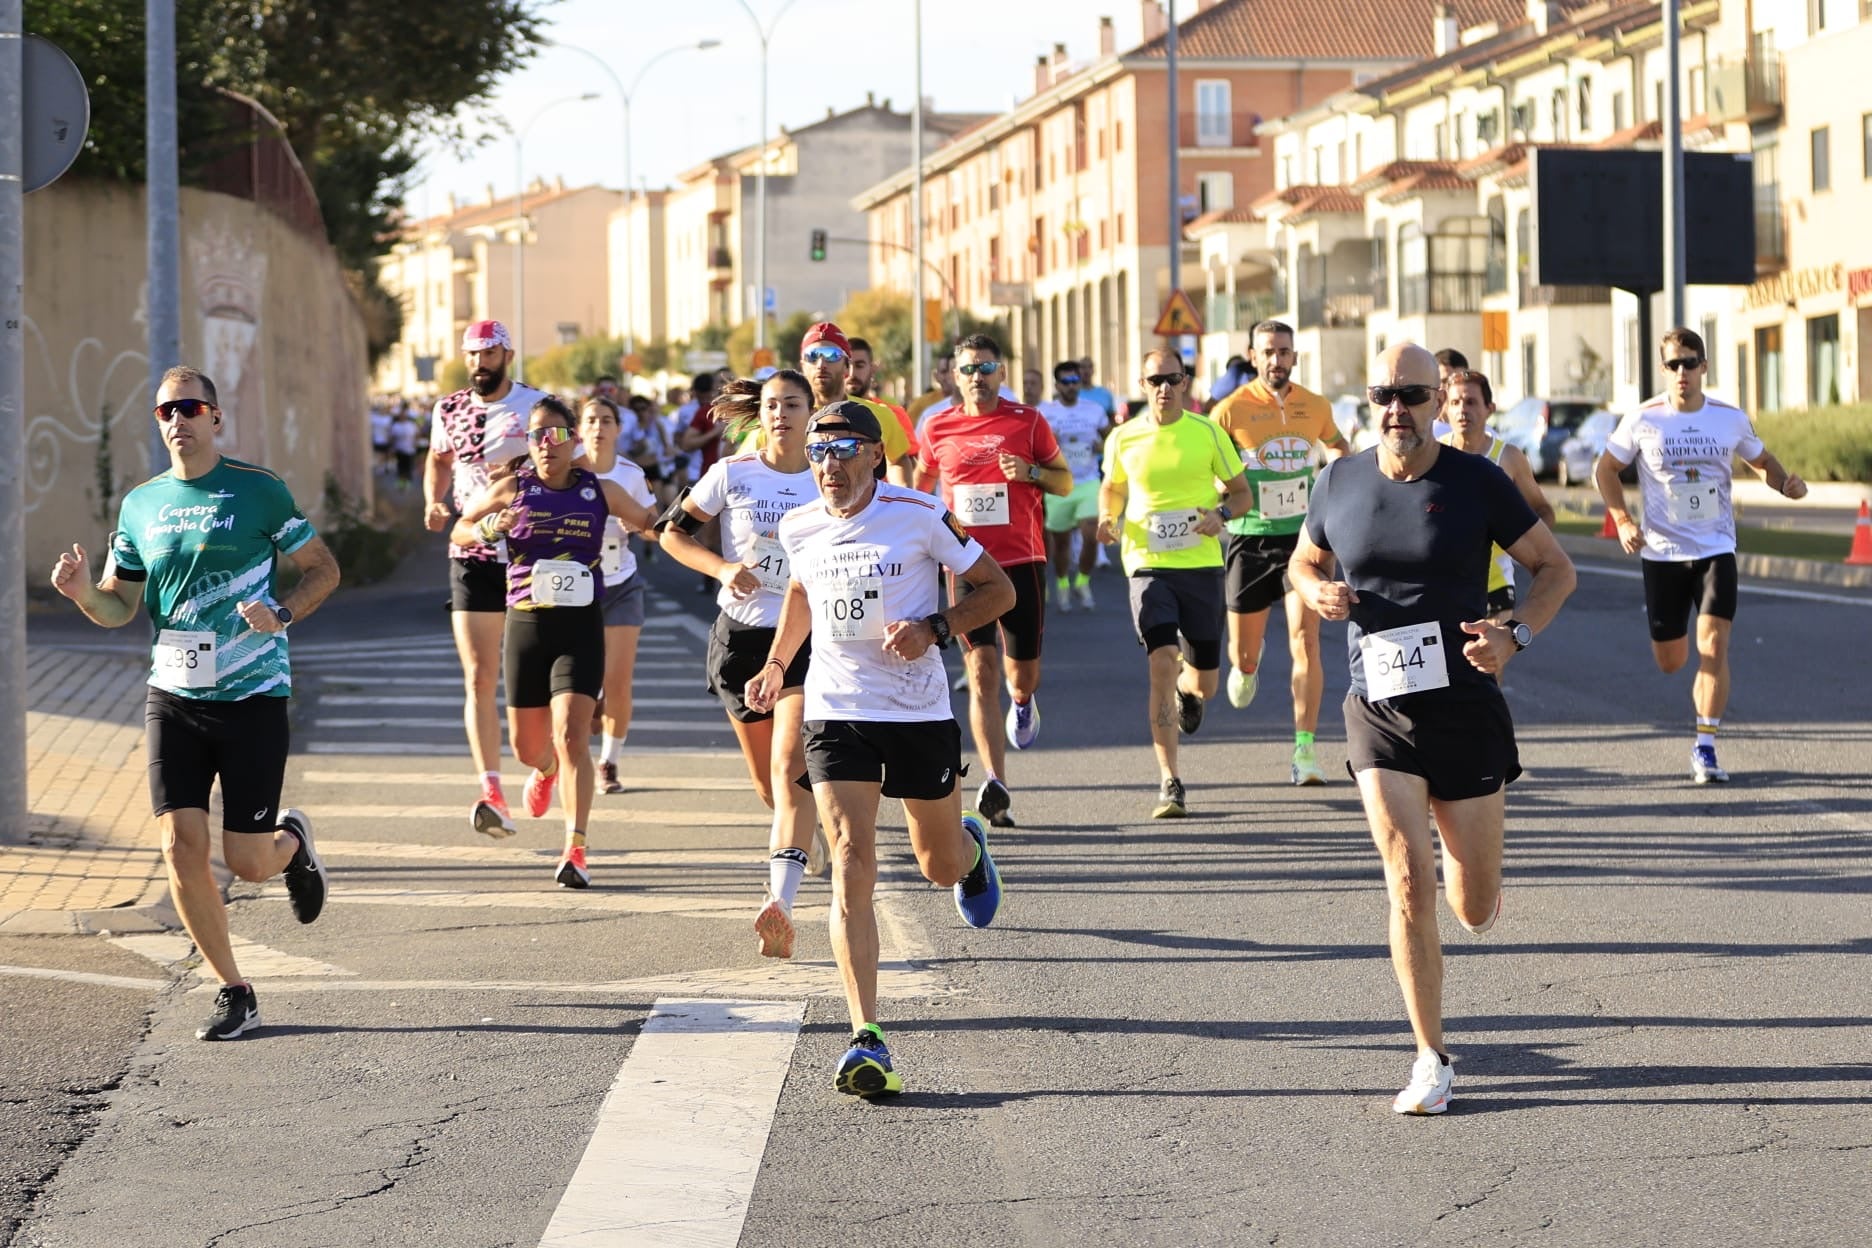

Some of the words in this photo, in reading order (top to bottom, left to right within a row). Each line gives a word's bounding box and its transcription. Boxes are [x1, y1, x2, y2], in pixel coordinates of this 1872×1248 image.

[1678, 437, 1717, 445] CARRERA
[1703, 447, 1729, 457] CIVIL
[757, 499, 768, 508] III
[964, 497, 996, 513] 232
[1277, 492, 1295, 506] 14
[1689, 495, 1700, 510] 9
[158, 503, 218, 522] Carrera
[199, 514, 235, 533] Civil
[1156, 521, 1189, 539] 322
[858, 563, 904, 578] CIVIL
[551, 575, 575, 592] 92
[822, 598, 864, 621] 108
[165, 648, 198, 669] 293
[1377, 645, 1426, 676] 544
